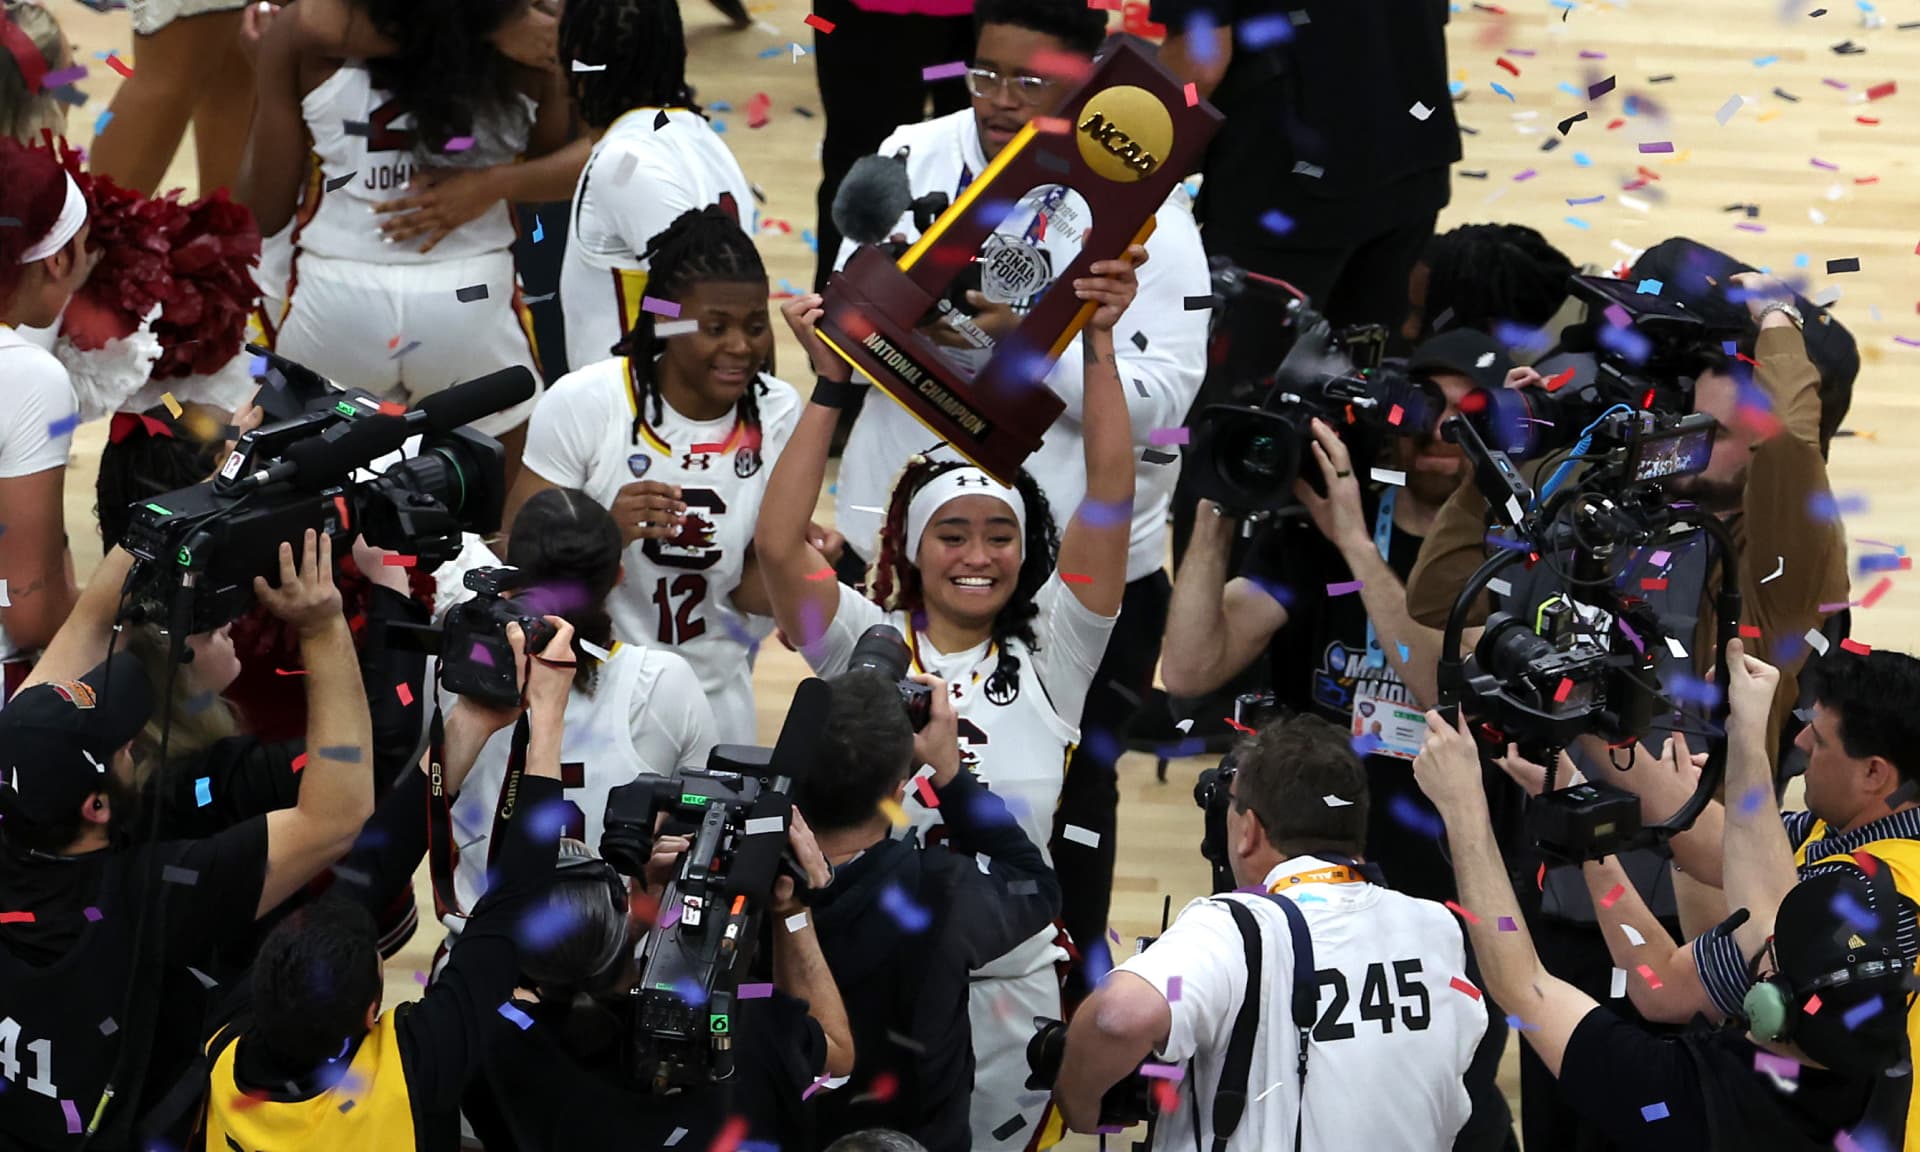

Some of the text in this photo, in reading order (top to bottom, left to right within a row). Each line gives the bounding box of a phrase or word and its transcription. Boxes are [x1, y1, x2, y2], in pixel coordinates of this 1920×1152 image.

[1080, 112, 1158, 174] NCAA
[990, 260, 1027, 292] FOUR
[1002, 249, 1034, 279] FINAL
[862, 332, 987, 435] NATIONAL CHAMPION
[653, 574, 708, 645] 12
[431, 762, 443, 797] EOS
[501, 770, 520, 820] Canon
[711, 1016, 727, 1031] 6
[1312, 958, 1431, 1043] 245
